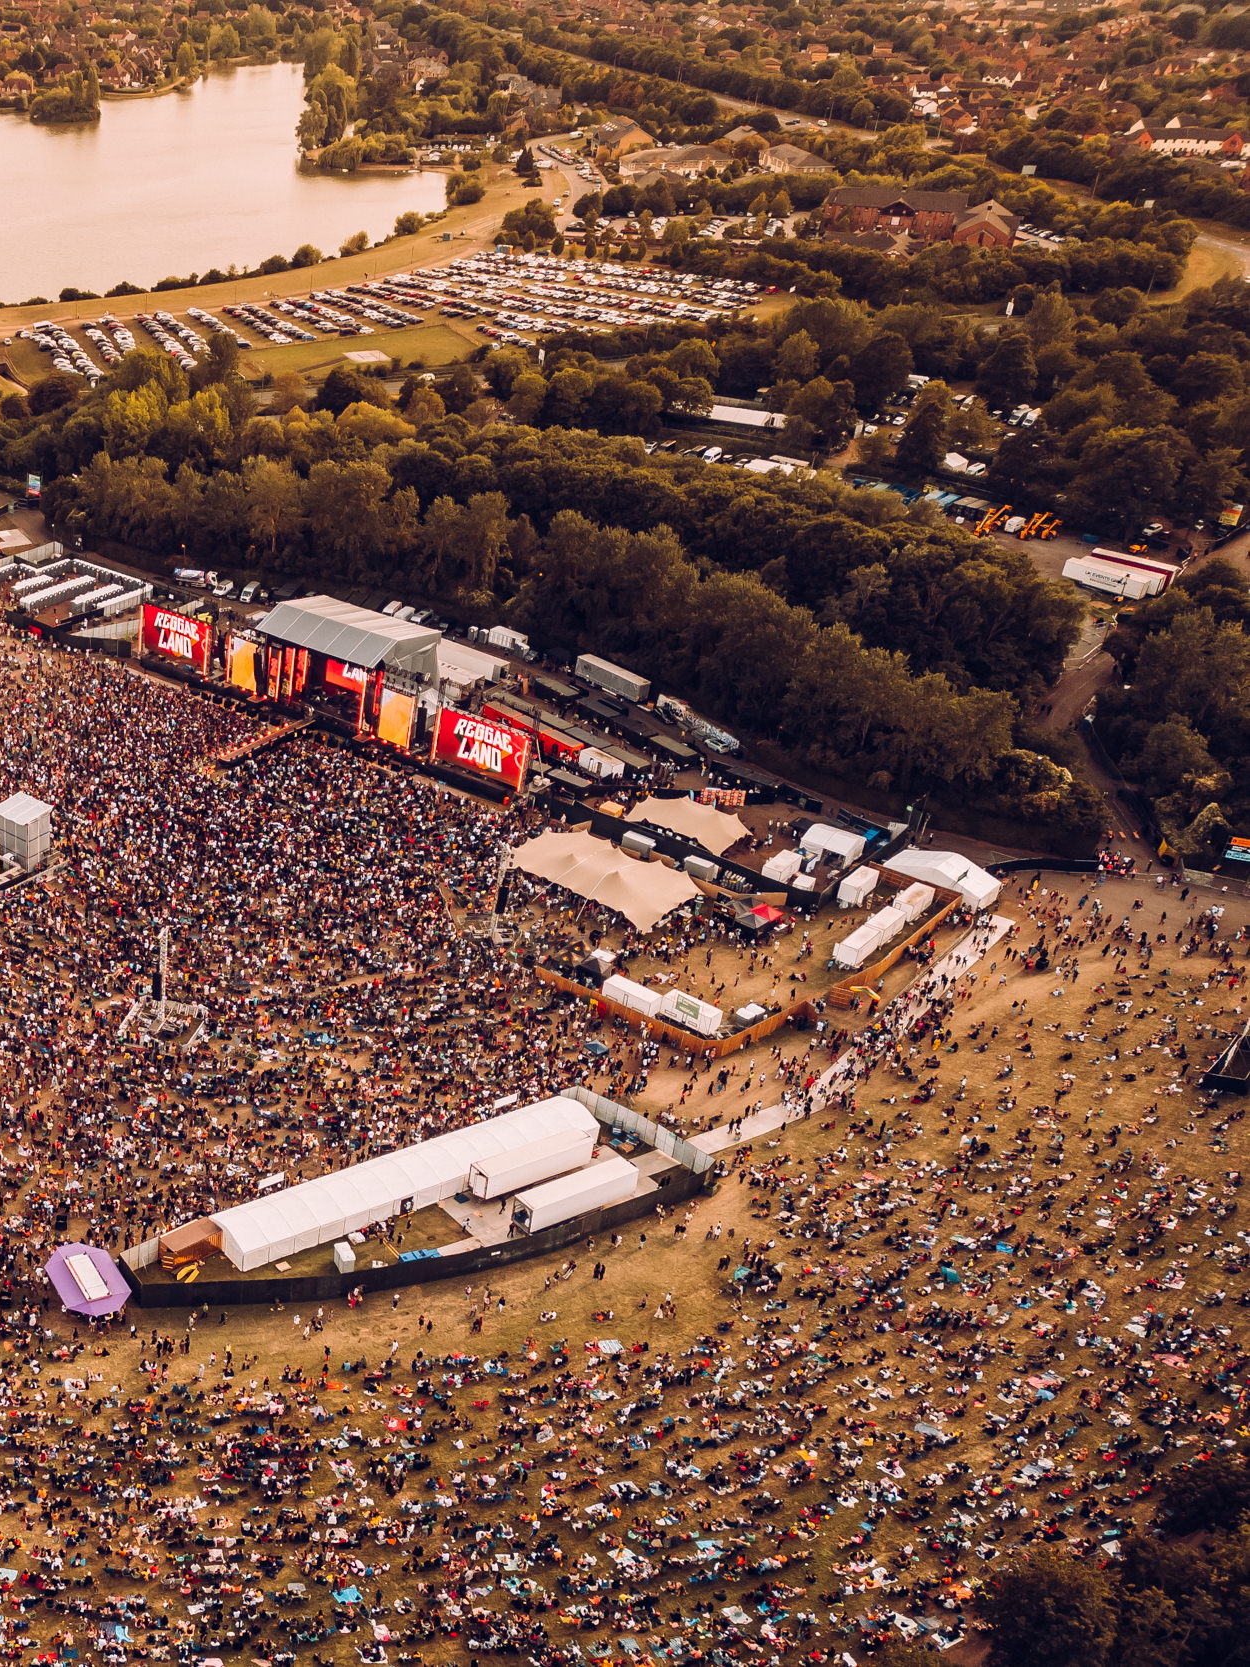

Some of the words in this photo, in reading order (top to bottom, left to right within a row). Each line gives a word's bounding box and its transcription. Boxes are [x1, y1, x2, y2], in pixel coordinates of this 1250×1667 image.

[1092, 572, 1110, 581] EVENTS
[154, 612, 200, 641] REGGAE
[158, 629, 192, 659] LAND
[453, 718, 513, 754] REGGAE
[457, 737, 502, 773] LAND
